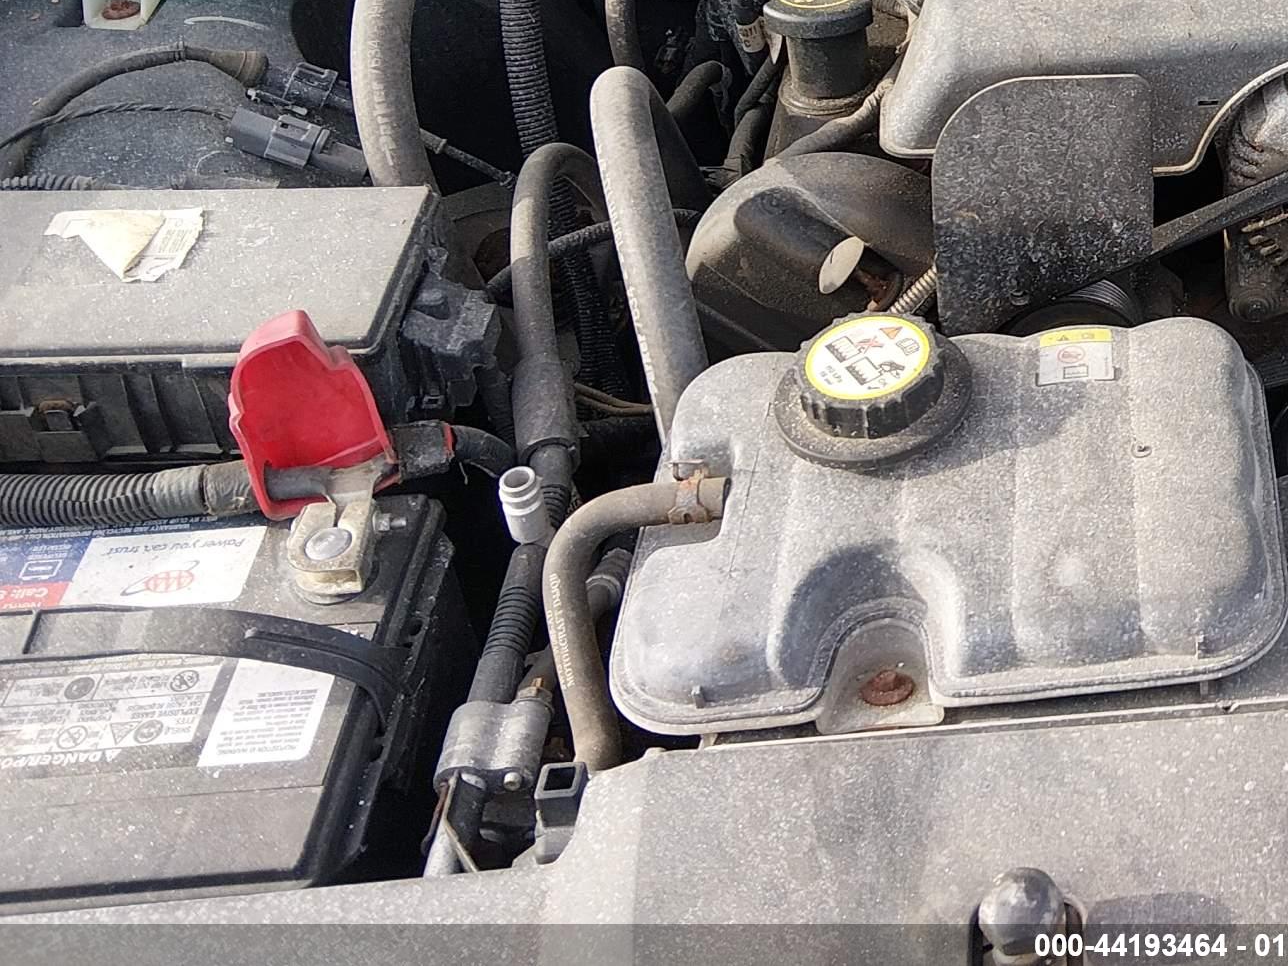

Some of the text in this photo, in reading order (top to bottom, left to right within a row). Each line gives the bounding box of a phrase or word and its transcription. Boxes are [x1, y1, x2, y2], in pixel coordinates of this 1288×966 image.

[105, 537, 245, 555] Power you can trust
